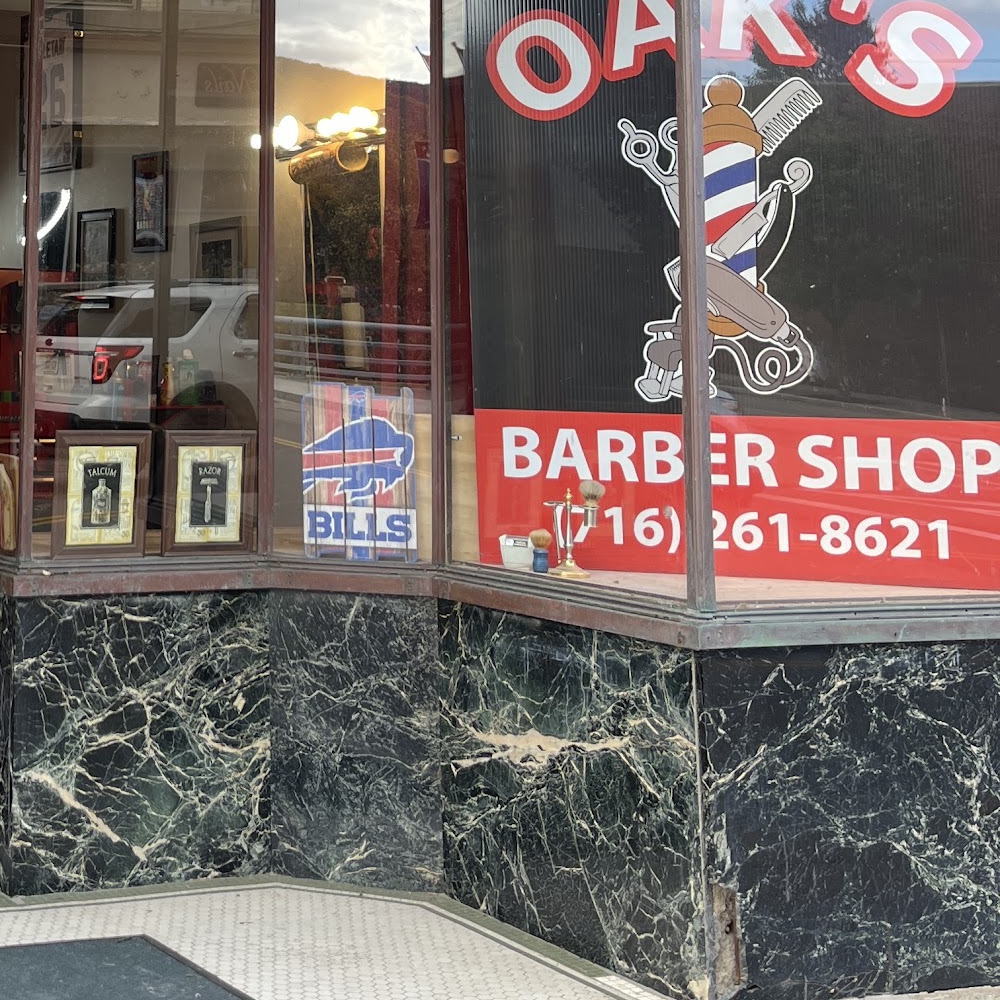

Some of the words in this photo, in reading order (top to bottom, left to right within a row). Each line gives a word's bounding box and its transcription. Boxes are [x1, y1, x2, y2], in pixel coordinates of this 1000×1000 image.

[87, 467, 117, 478] TALCUM
[199, 467, 222, 476] RAZOR
[502, 427, 778, 487] BARBER
[798, 434, 1000, 494] SHOP
[307, 510, 412, 543] BILLS
[712, 510, 950, 560] 261-8621
